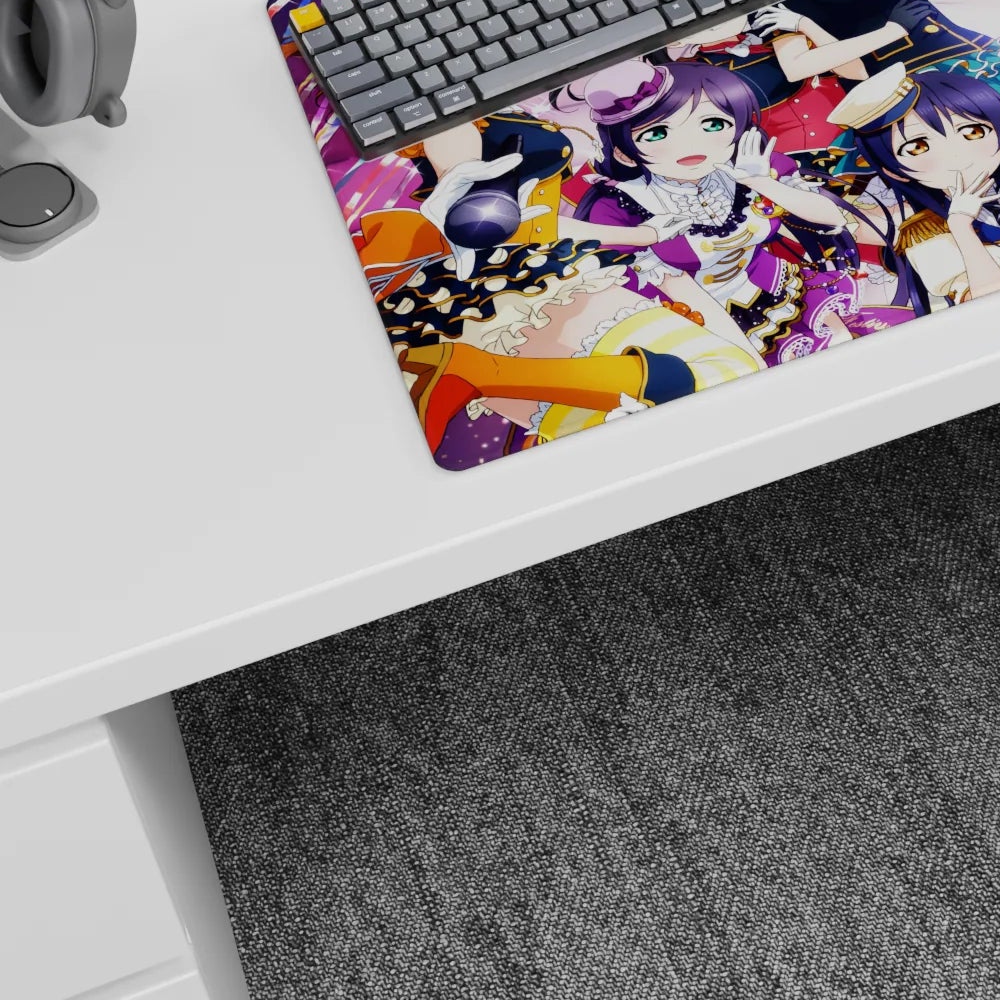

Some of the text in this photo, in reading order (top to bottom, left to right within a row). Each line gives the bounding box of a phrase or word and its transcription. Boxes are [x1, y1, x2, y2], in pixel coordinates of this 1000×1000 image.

[347, 70, 361, 78] caps
[368, 89, 382, 98] shift
[438, 84, 466, 99] command
[403, 102, 422, 112] option
[362, 116, 383, 128] control
